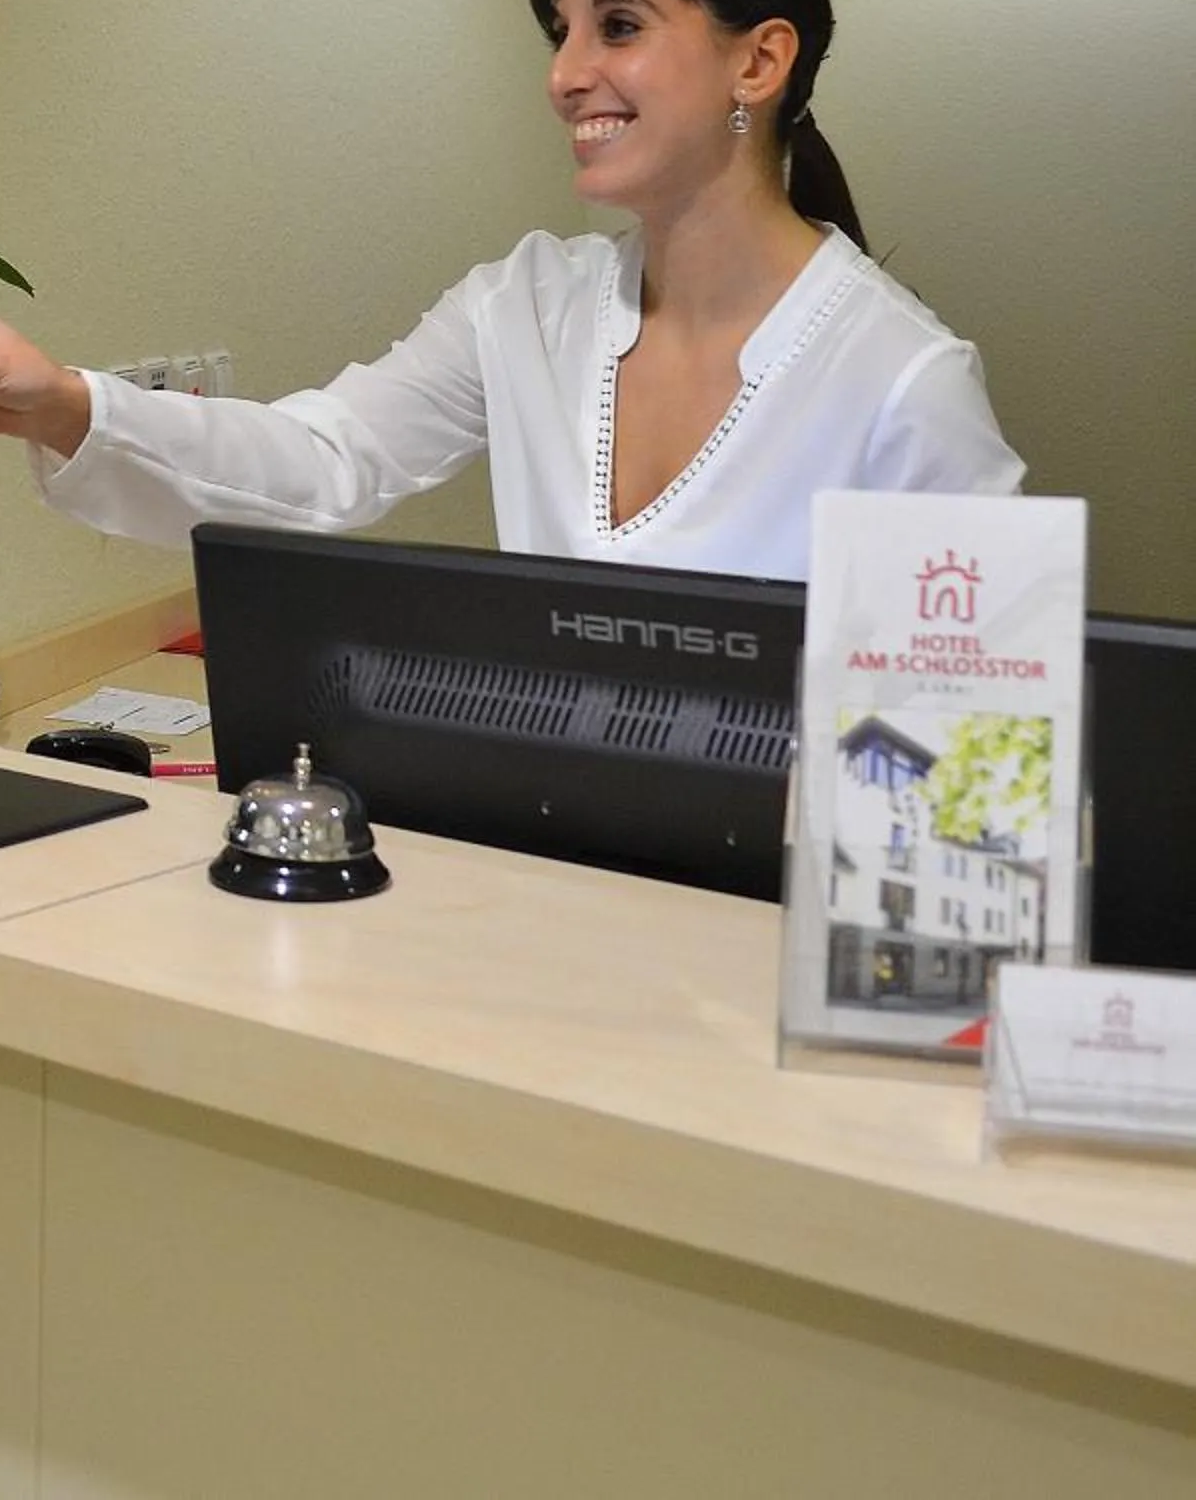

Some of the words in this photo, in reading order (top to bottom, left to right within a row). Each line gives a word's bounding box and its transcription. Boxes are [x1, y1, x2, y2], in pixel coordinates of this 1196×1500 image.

[910, 633, 986, 655] HOTEL
[847, 650, 888, 671] AM
[895, 653, 1047, 679] SCHLOSSTOR
